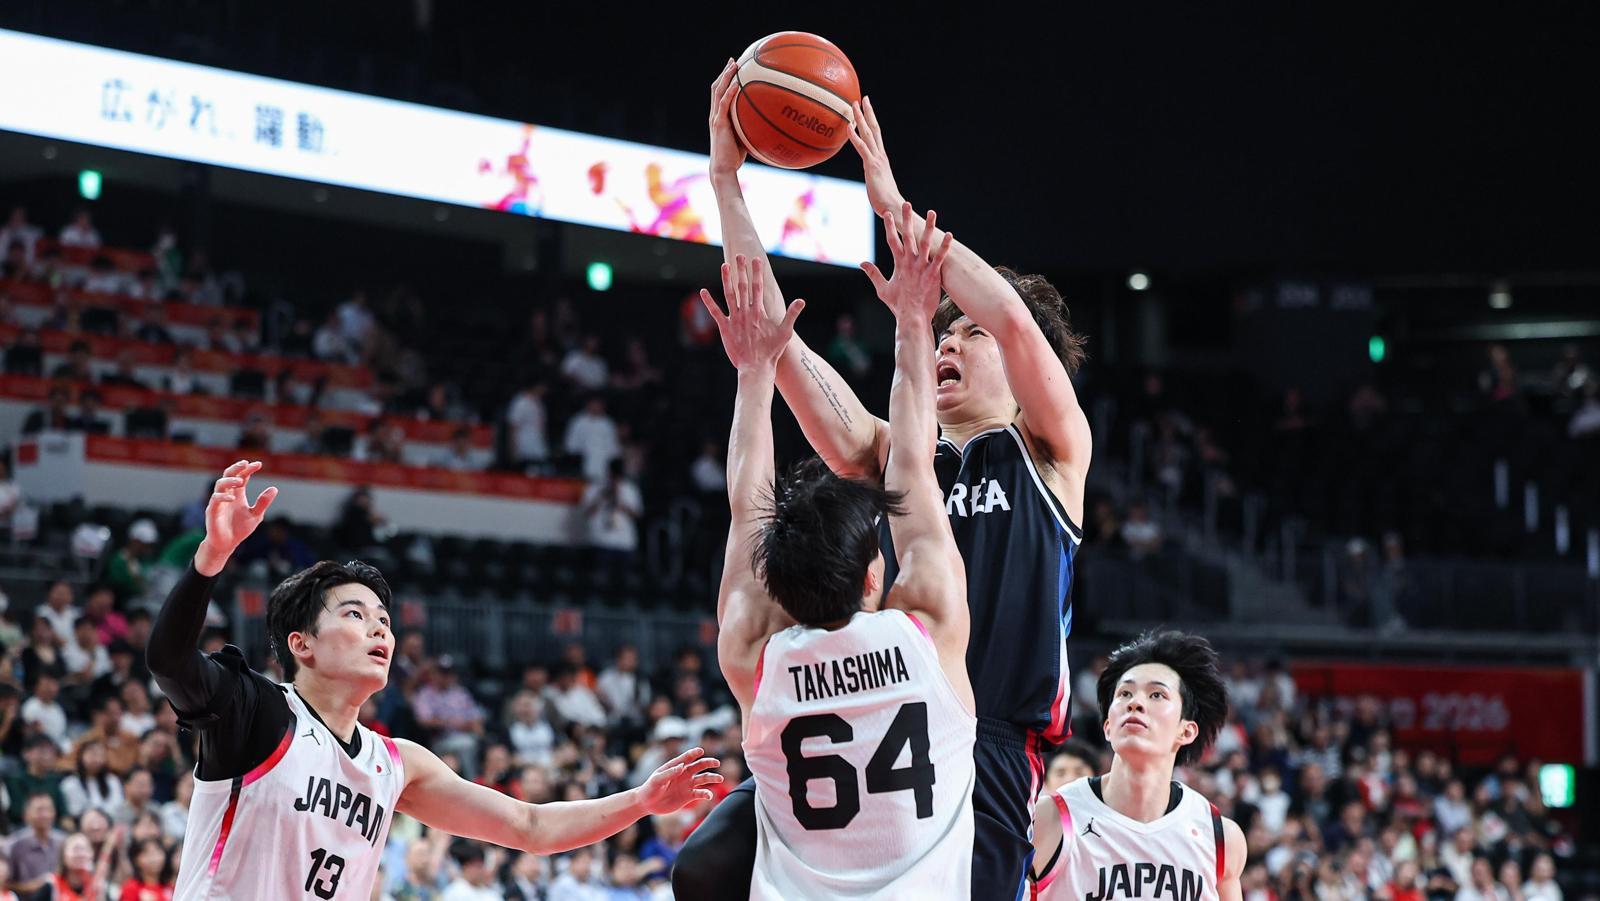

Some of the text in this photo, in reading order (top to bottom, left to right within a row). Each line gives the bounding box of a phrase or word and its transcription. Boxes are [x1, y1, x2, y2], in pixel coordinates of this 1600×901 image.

[781, 105, 835, 139] molten
[945, 477, 1011, 518] REA
[788, 646, 910, 702] TAKASHIMA
[780, 701, 936, 831] 64
[294, 776, 386, 848] JAPAN
[304, 847, 345, 900] 13
[1085, 862, 1203, 901] JAPAN
